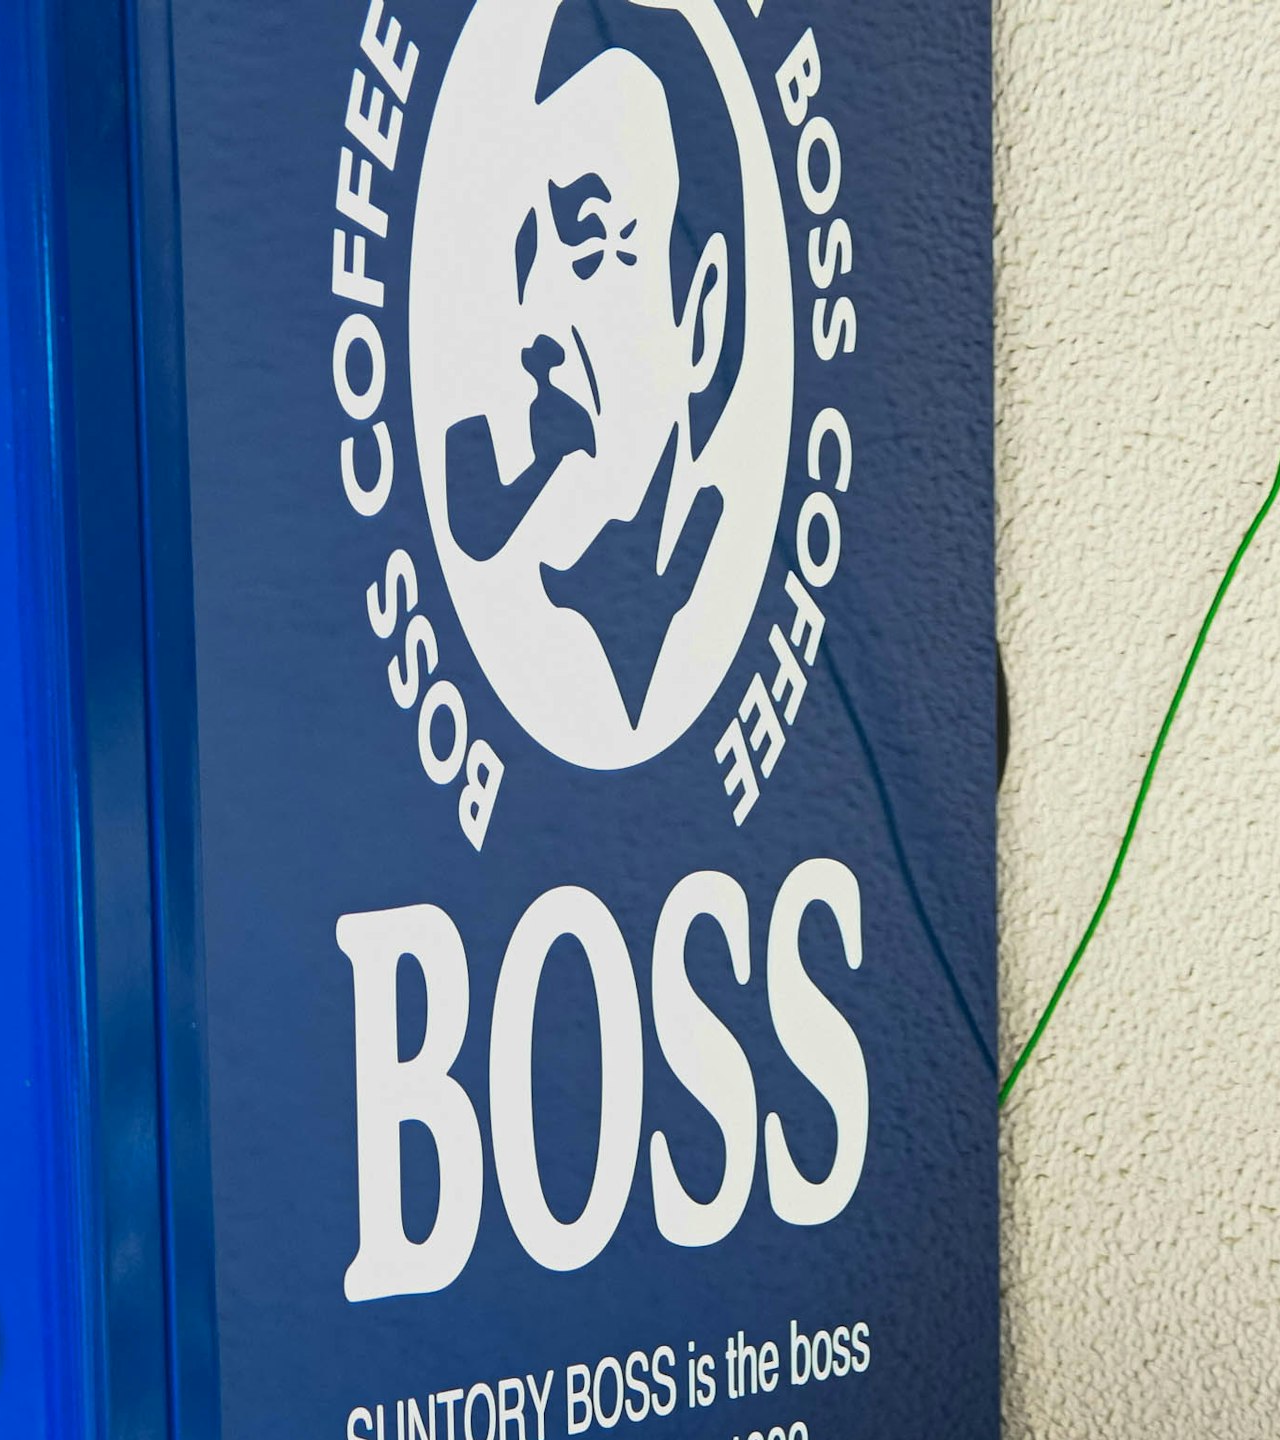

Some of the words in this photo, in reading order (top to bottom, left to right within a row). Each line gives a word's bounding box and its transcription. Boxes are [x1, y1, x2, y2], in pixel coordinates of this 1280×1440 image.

[332, 0, 420, 517] COFFEE
[775, 27, 857, 361] BOSS
[366, 548, 505, 852] BOSS
[714, 406, 853, 826] COFFEE
[335, 857, 869, 1302] BOSS
[567, 1345, 675, 1437] BOSS
[688, 1342, 716, 1408] is
[725, 1331, 779, 1399] the
[791, 1321, 871, 1386] boss
